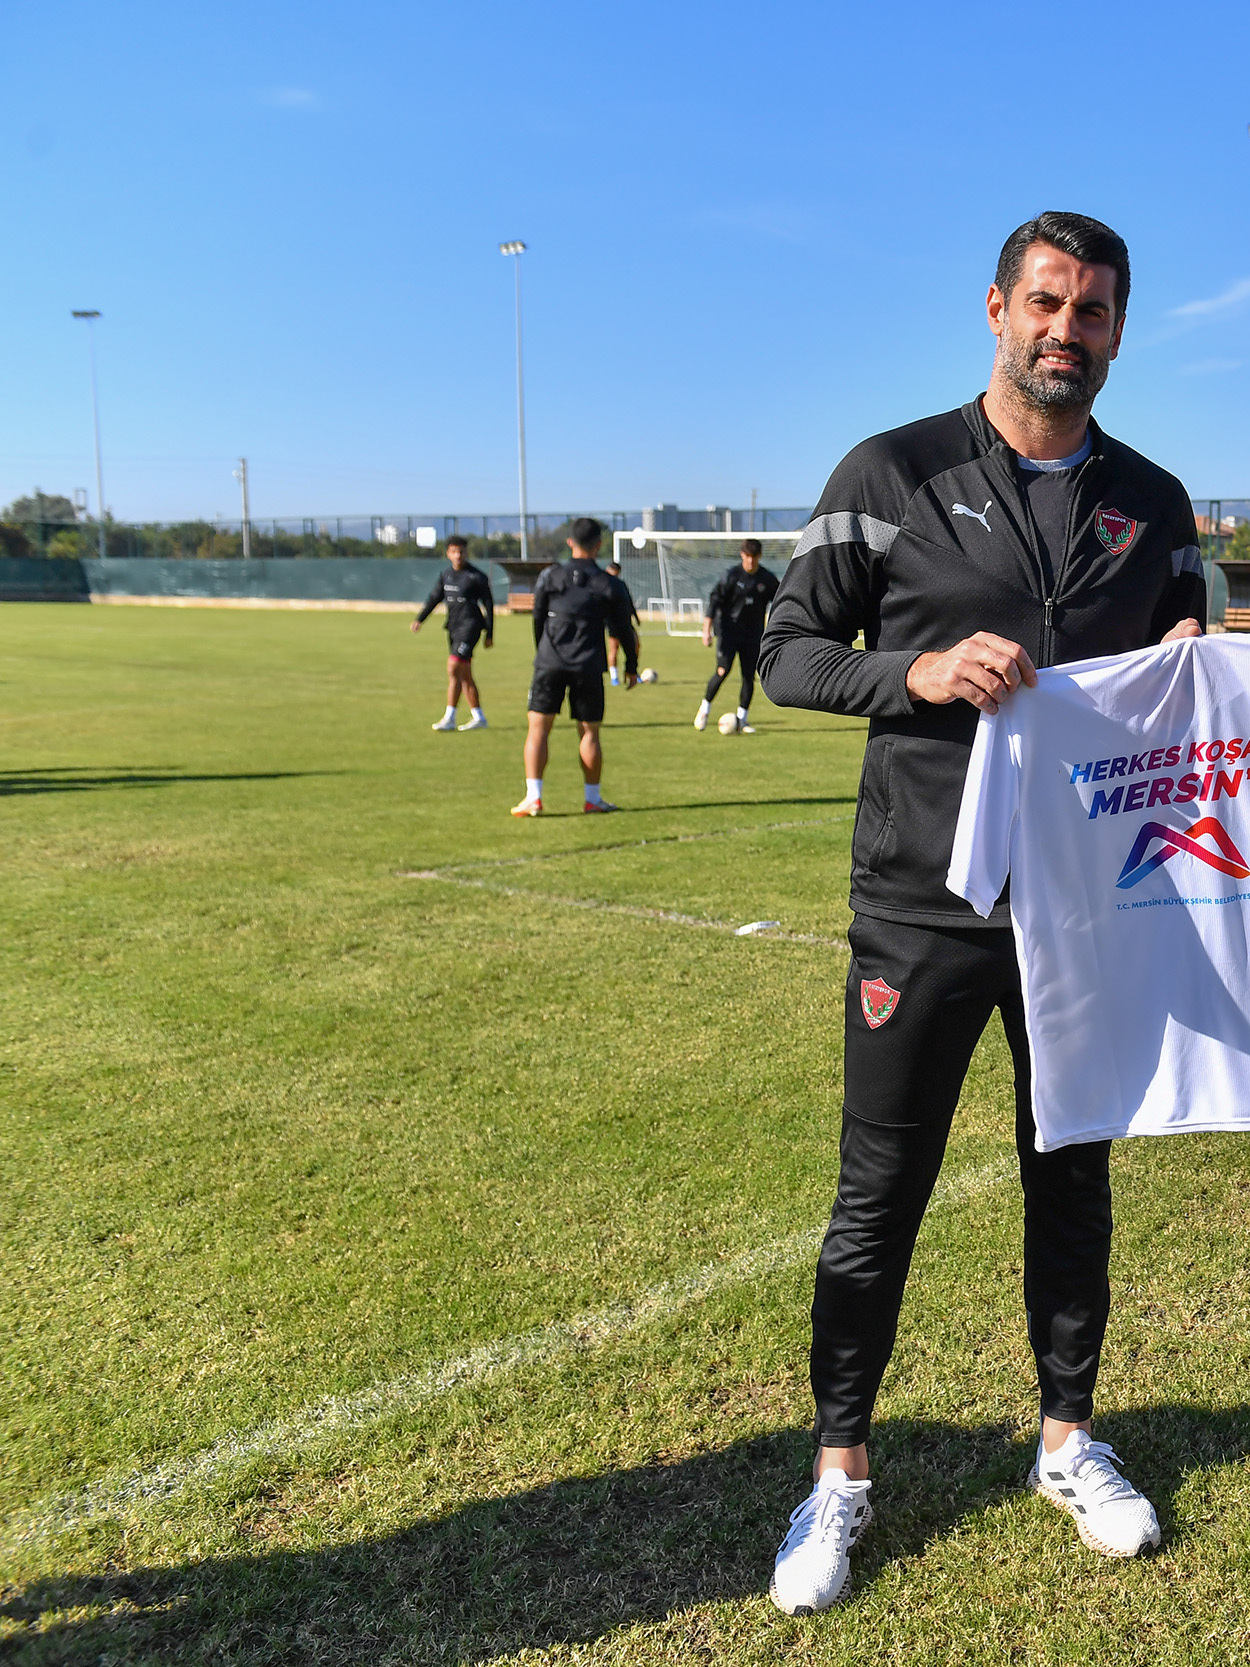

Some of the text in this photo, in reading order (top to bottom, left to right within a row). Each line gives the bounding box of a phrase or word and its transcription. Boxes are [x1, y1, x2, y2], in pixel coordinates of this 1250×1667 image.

[1069, 745, 1182, 784] HERKES
[1131, 898, 1161, 909] MERSİN
[1163, 896, 1212, 906] BÜYÜKŞEHİR
